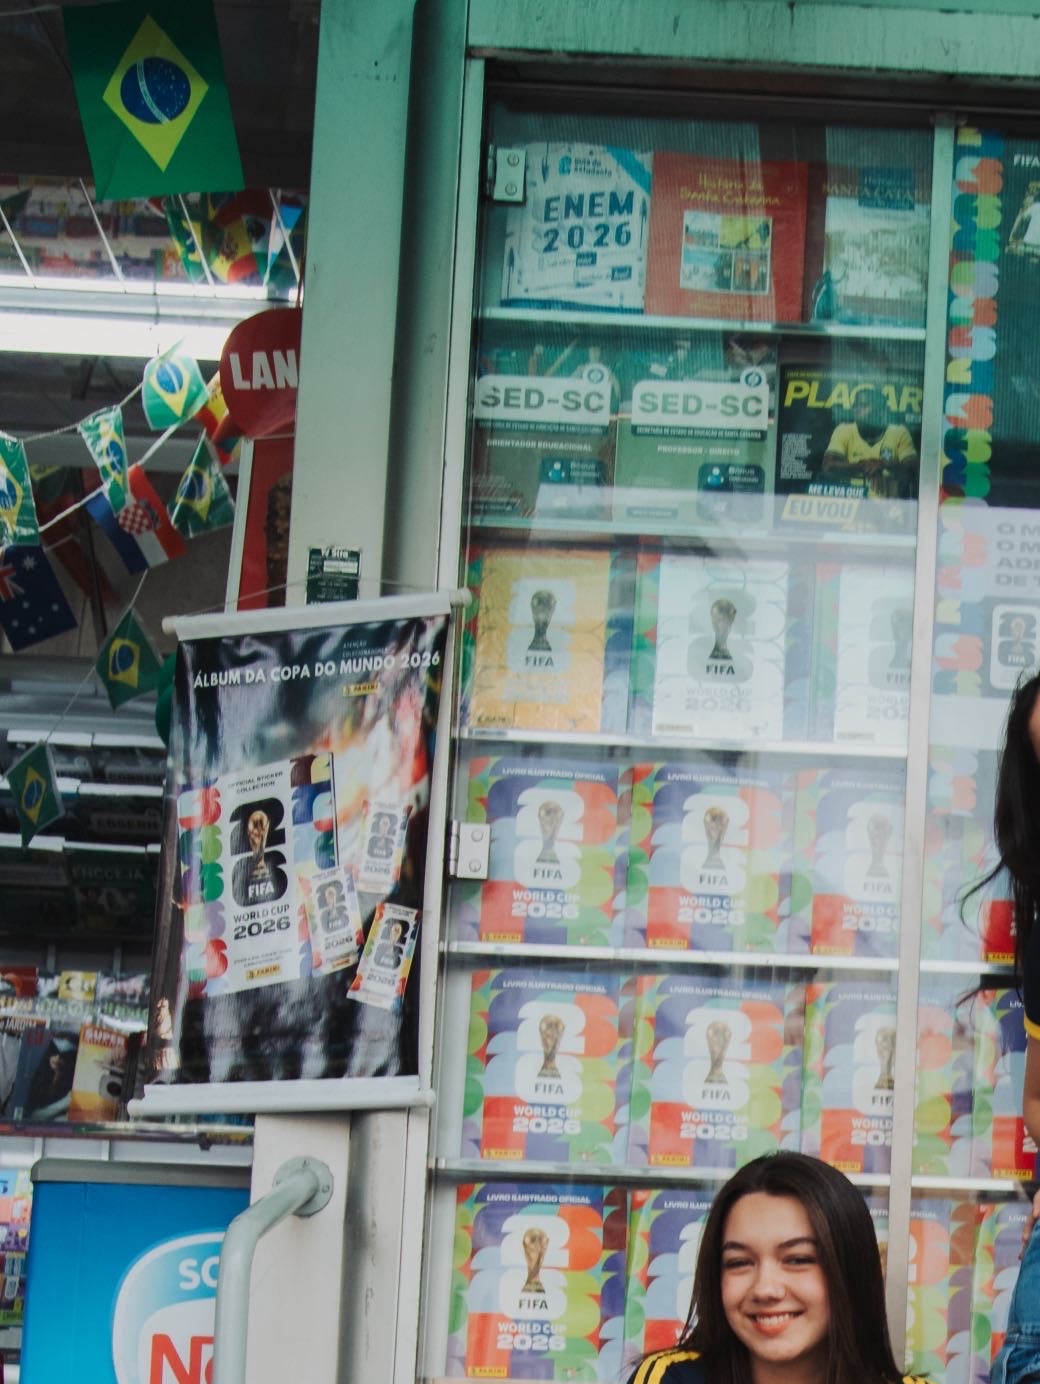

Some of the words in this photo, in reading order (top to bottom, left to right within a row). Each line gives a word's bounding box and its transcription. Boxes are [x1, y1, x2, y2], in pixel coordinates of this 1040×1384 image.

[1013, 154, 1040, 167] FIFA
[543, 191, 635, 222] ENEM
[543, 222, 631, 253] 2026
[229, 350, 299, 390] LAN
[480, 387, 604, 413] SED-SC
[639, 392, 763, 418] SED-SC
[824, 485, 844, 496] LEVA
[816, 501, 851, 519] VOU
[994, 575, 1027, 587] DE
[525, 656, 554, 667] FIFA
[193, 671, 241, 689] ÁLBUM
[246, 669, 266, 683] DA
[270, 665, 310, 682] COPA
[315, 662, 335, 677] DO
[339, 655, 396, 674] MUNDO
[400, 650, 440, 668] 2026
[705, 664, 735, 676] FIFA
[533, 868, 563, 880] FIFA
[700, 874, 728, 885] FIFA
[248, 881, 275, 898] FIFA
[864, 882, 893, 893] FIFA
[513, 890, 555, 901] WORLD
[557, 893, 581, 903] CUP
[680, 896, 719, 907] WORLD
[233, 909, 269, 923] WORLD
[271, 904, 290, 916] CUP
[511, 903, 580, 919] 2026
[677, 908, 745, 925] 2026
[233, 916, 291, 940] 2026
[842, 916, 899, 932] 202
[503, 981, 527, 989] LIVRO
[534, 1083, 564, 1094] FIFA
[701, 1089, 730, 1100] FIFA
[871, 1095, 894, 1106] FIF
[514, 1104, 557, 1117] WORLD
[558, 1107, 582, 1118] CUP
[681, 1111, 723, 1123] WORLD
[512, 1118, 581, 1135] 2026
[680, 1124, 748, 1141] 2026
[486, 1193, 510, 1202] LIVRO
[511, 1194, 557, 1203] ILUSTRADO
[664, 1200, 689, 1209] LIVRO
[519, 1300, 548, 1309] FIFA
[498, 1322, 541, 1333] WORLD
[543, 1323, 566, 1334] CUP
[496, 1334, 567, 1350] 2026
